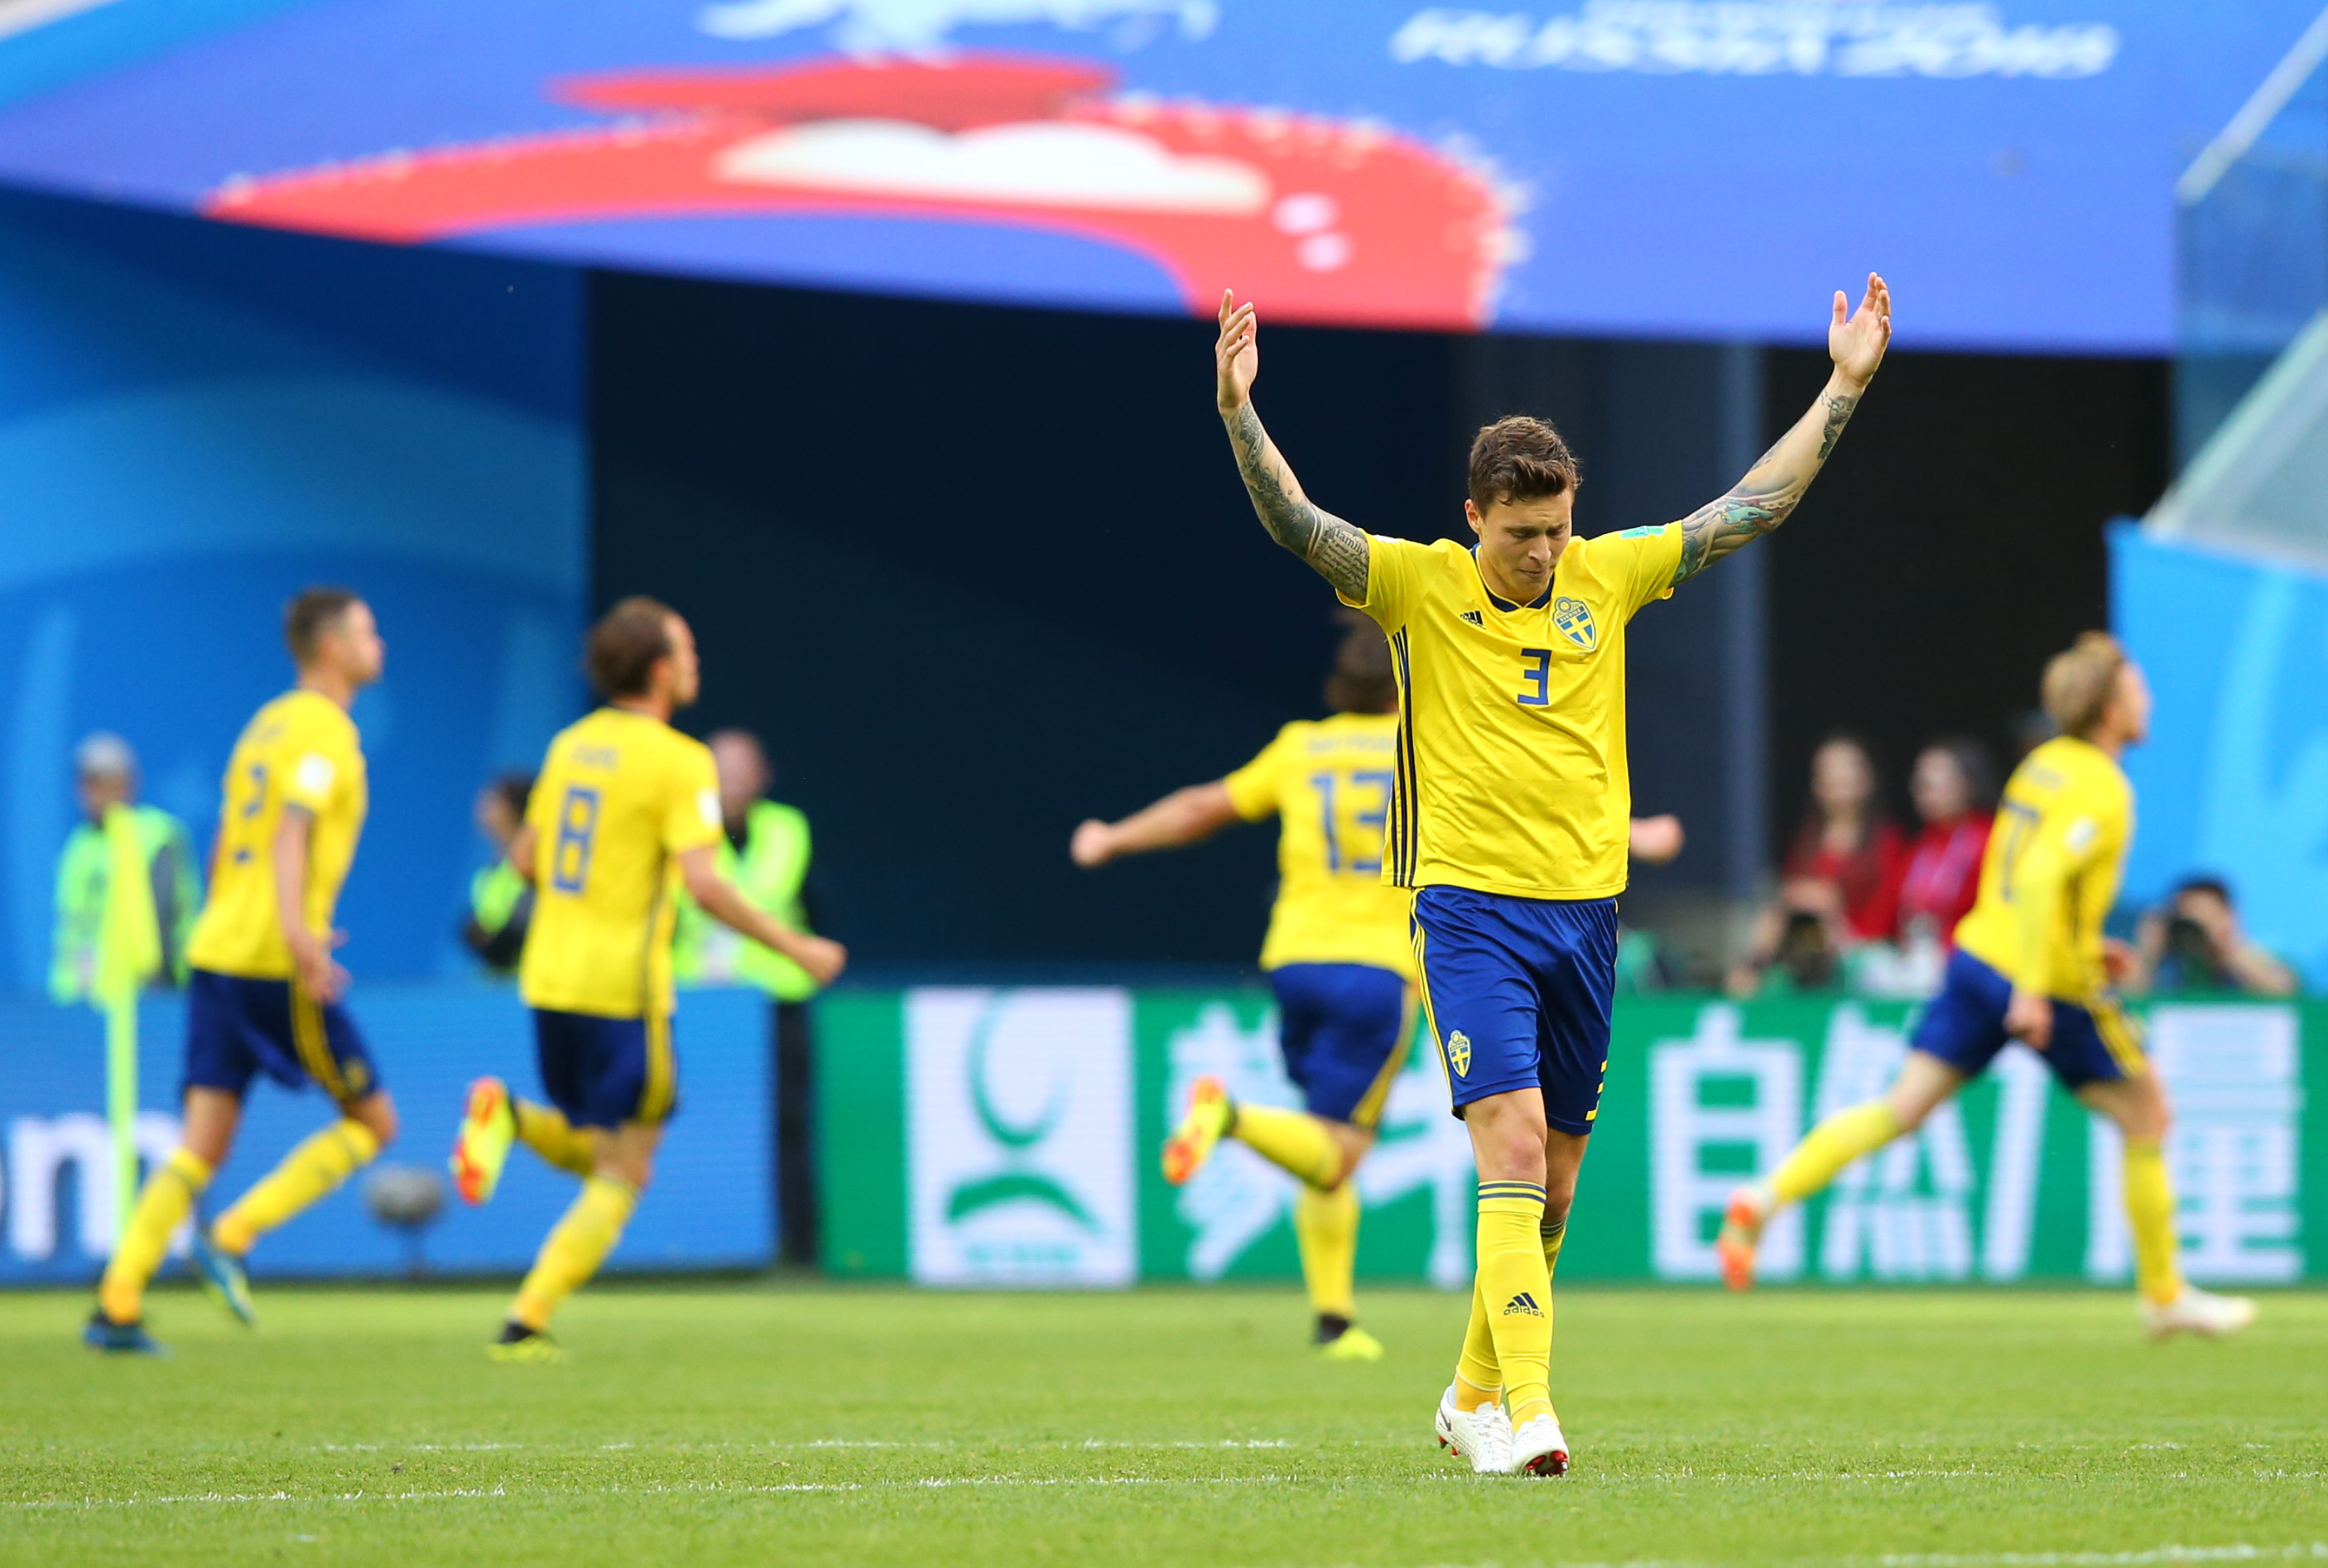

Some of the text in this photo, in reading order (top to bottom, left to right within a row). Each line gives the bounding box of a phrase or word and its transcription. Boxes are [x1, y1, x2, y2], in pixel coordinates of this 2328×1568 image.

[1335, 530, 1365, 555] family
[1518, 648, 1552, 705] 3
[551, 786, 604, 892] 8
[1309, 768, 1394, 873] 13
[1503, 1306, 1545, 1318] adidas
